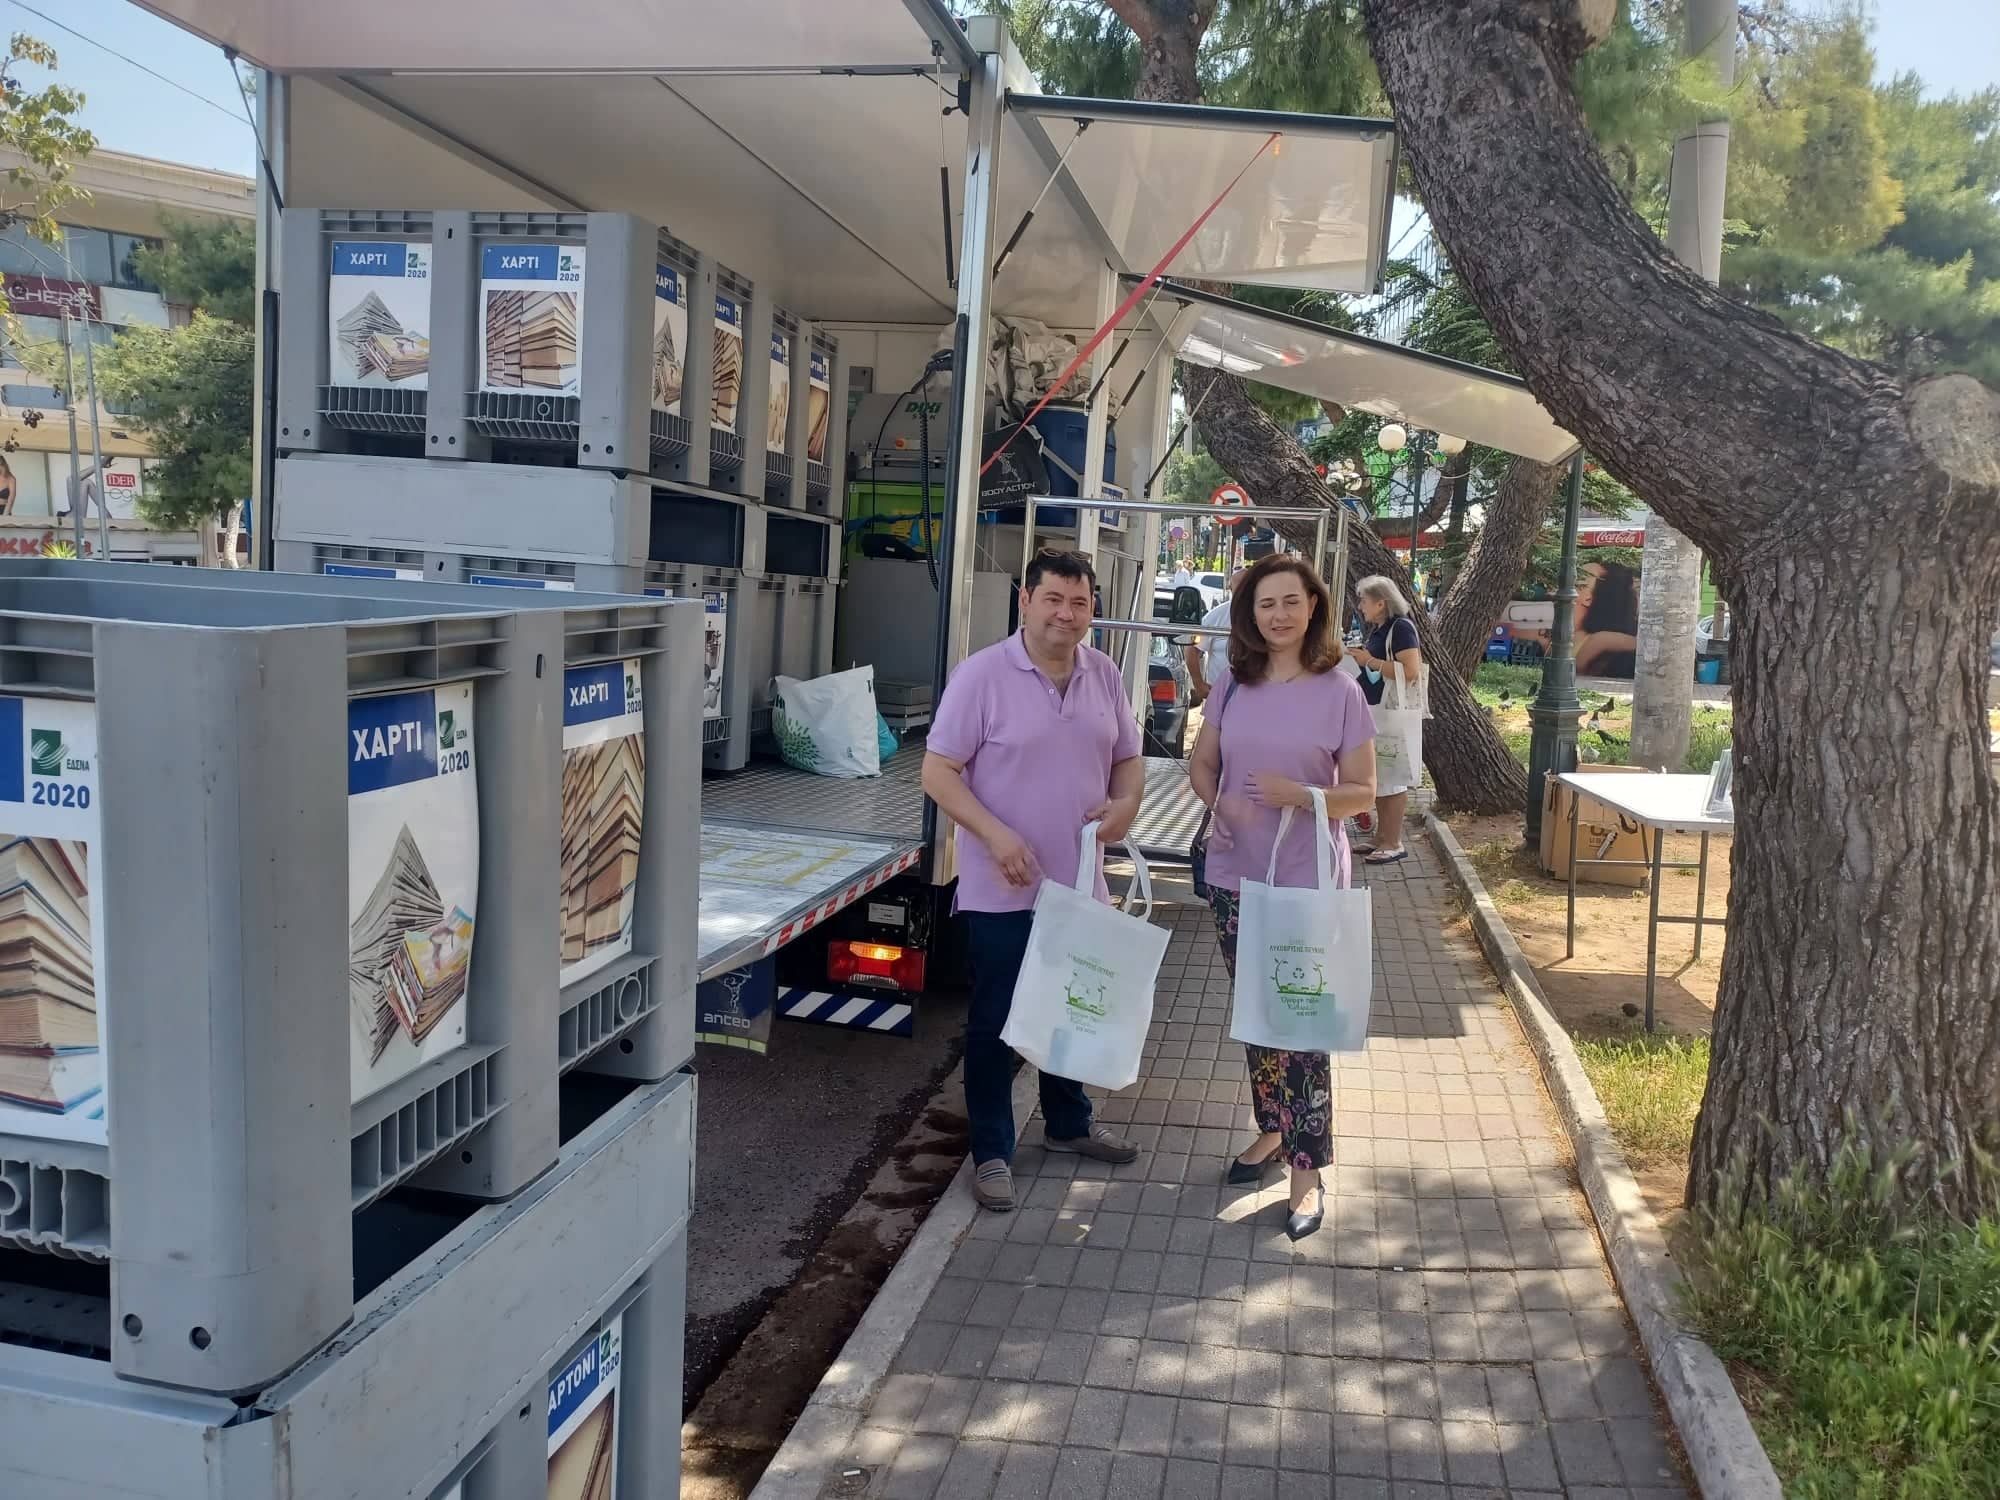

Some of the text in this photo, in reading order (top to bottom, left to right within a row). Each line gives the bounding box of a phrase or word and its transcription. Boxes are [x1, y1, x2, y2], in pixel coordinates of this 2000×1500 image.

[350, 253, 387, 266] ΧΑΡΤΙ
[501, 256, 539, 269] ΧΑΡΤΙ
[407, 270, 427, 279] 2020
[559, 273, 580, 282] 2020
[568, 682, 609, 707] ΧΑΡΤΙ
[626, 700, 642, 714] 2020
[352, 720, 422, 762] ΧΑΡΤΙ
[440, 750, 470, 775] 2020
[32, 781, 90, 810] 2020
[703, 1012, 751, 1029] anteo
[600, 1351, 620, 1384] 2020
